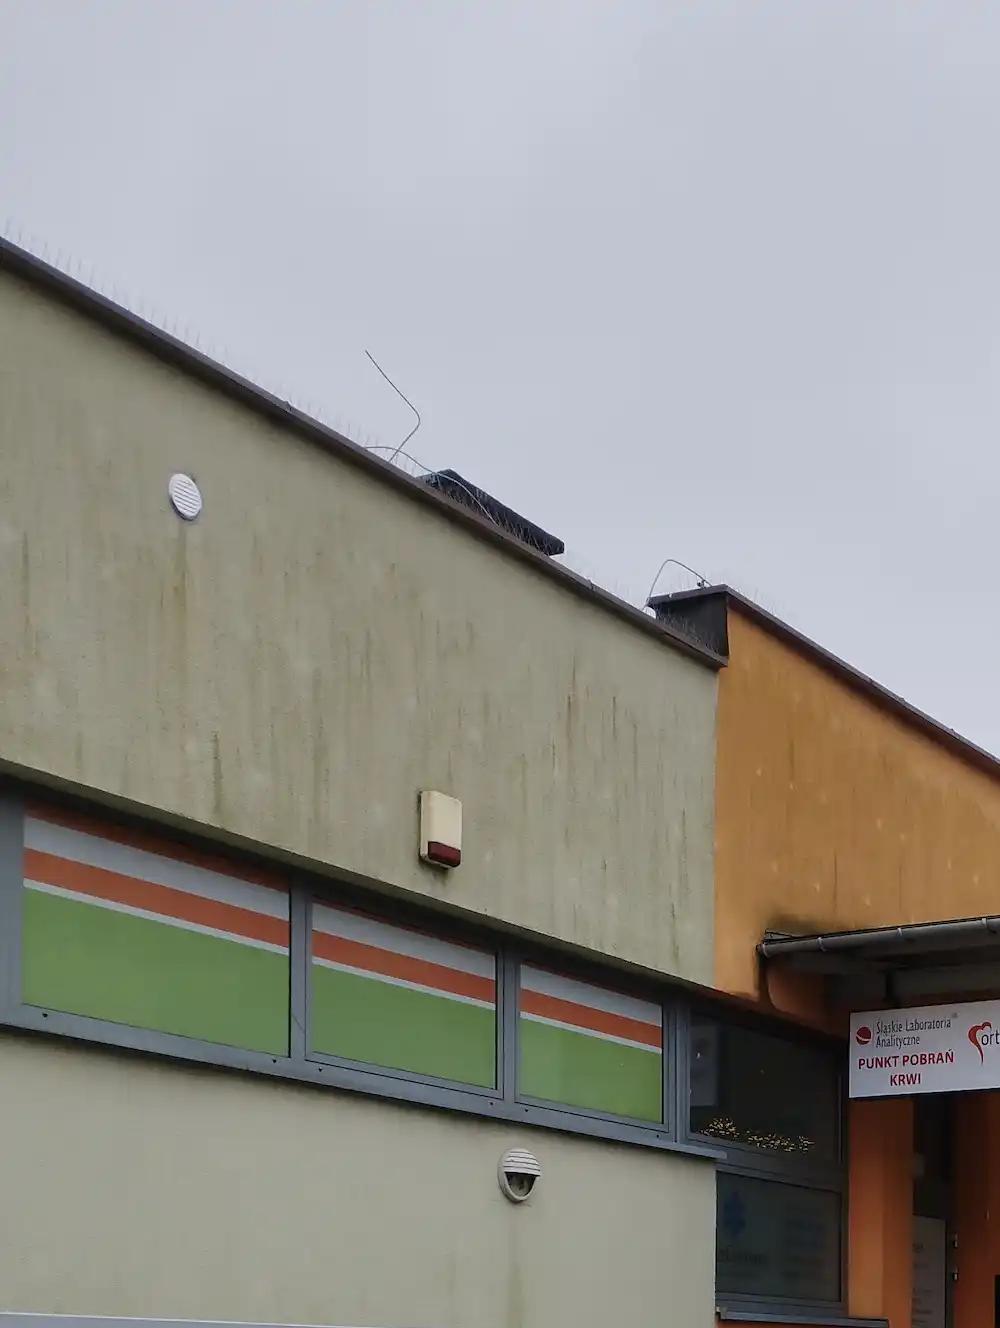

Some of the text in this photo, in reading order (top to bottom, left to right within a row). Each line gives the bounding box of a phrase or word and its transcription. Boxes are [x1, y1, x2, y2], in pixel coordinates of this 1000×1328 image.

[875, 1016, 952, 1038] Śląskie Laboratoria
[875, 1033, 921, 1050] Analityczne
[858, 1048, 955, 1070] PUNKT POBRAŃ
[889, 1073, 922, 1087] KRWI
